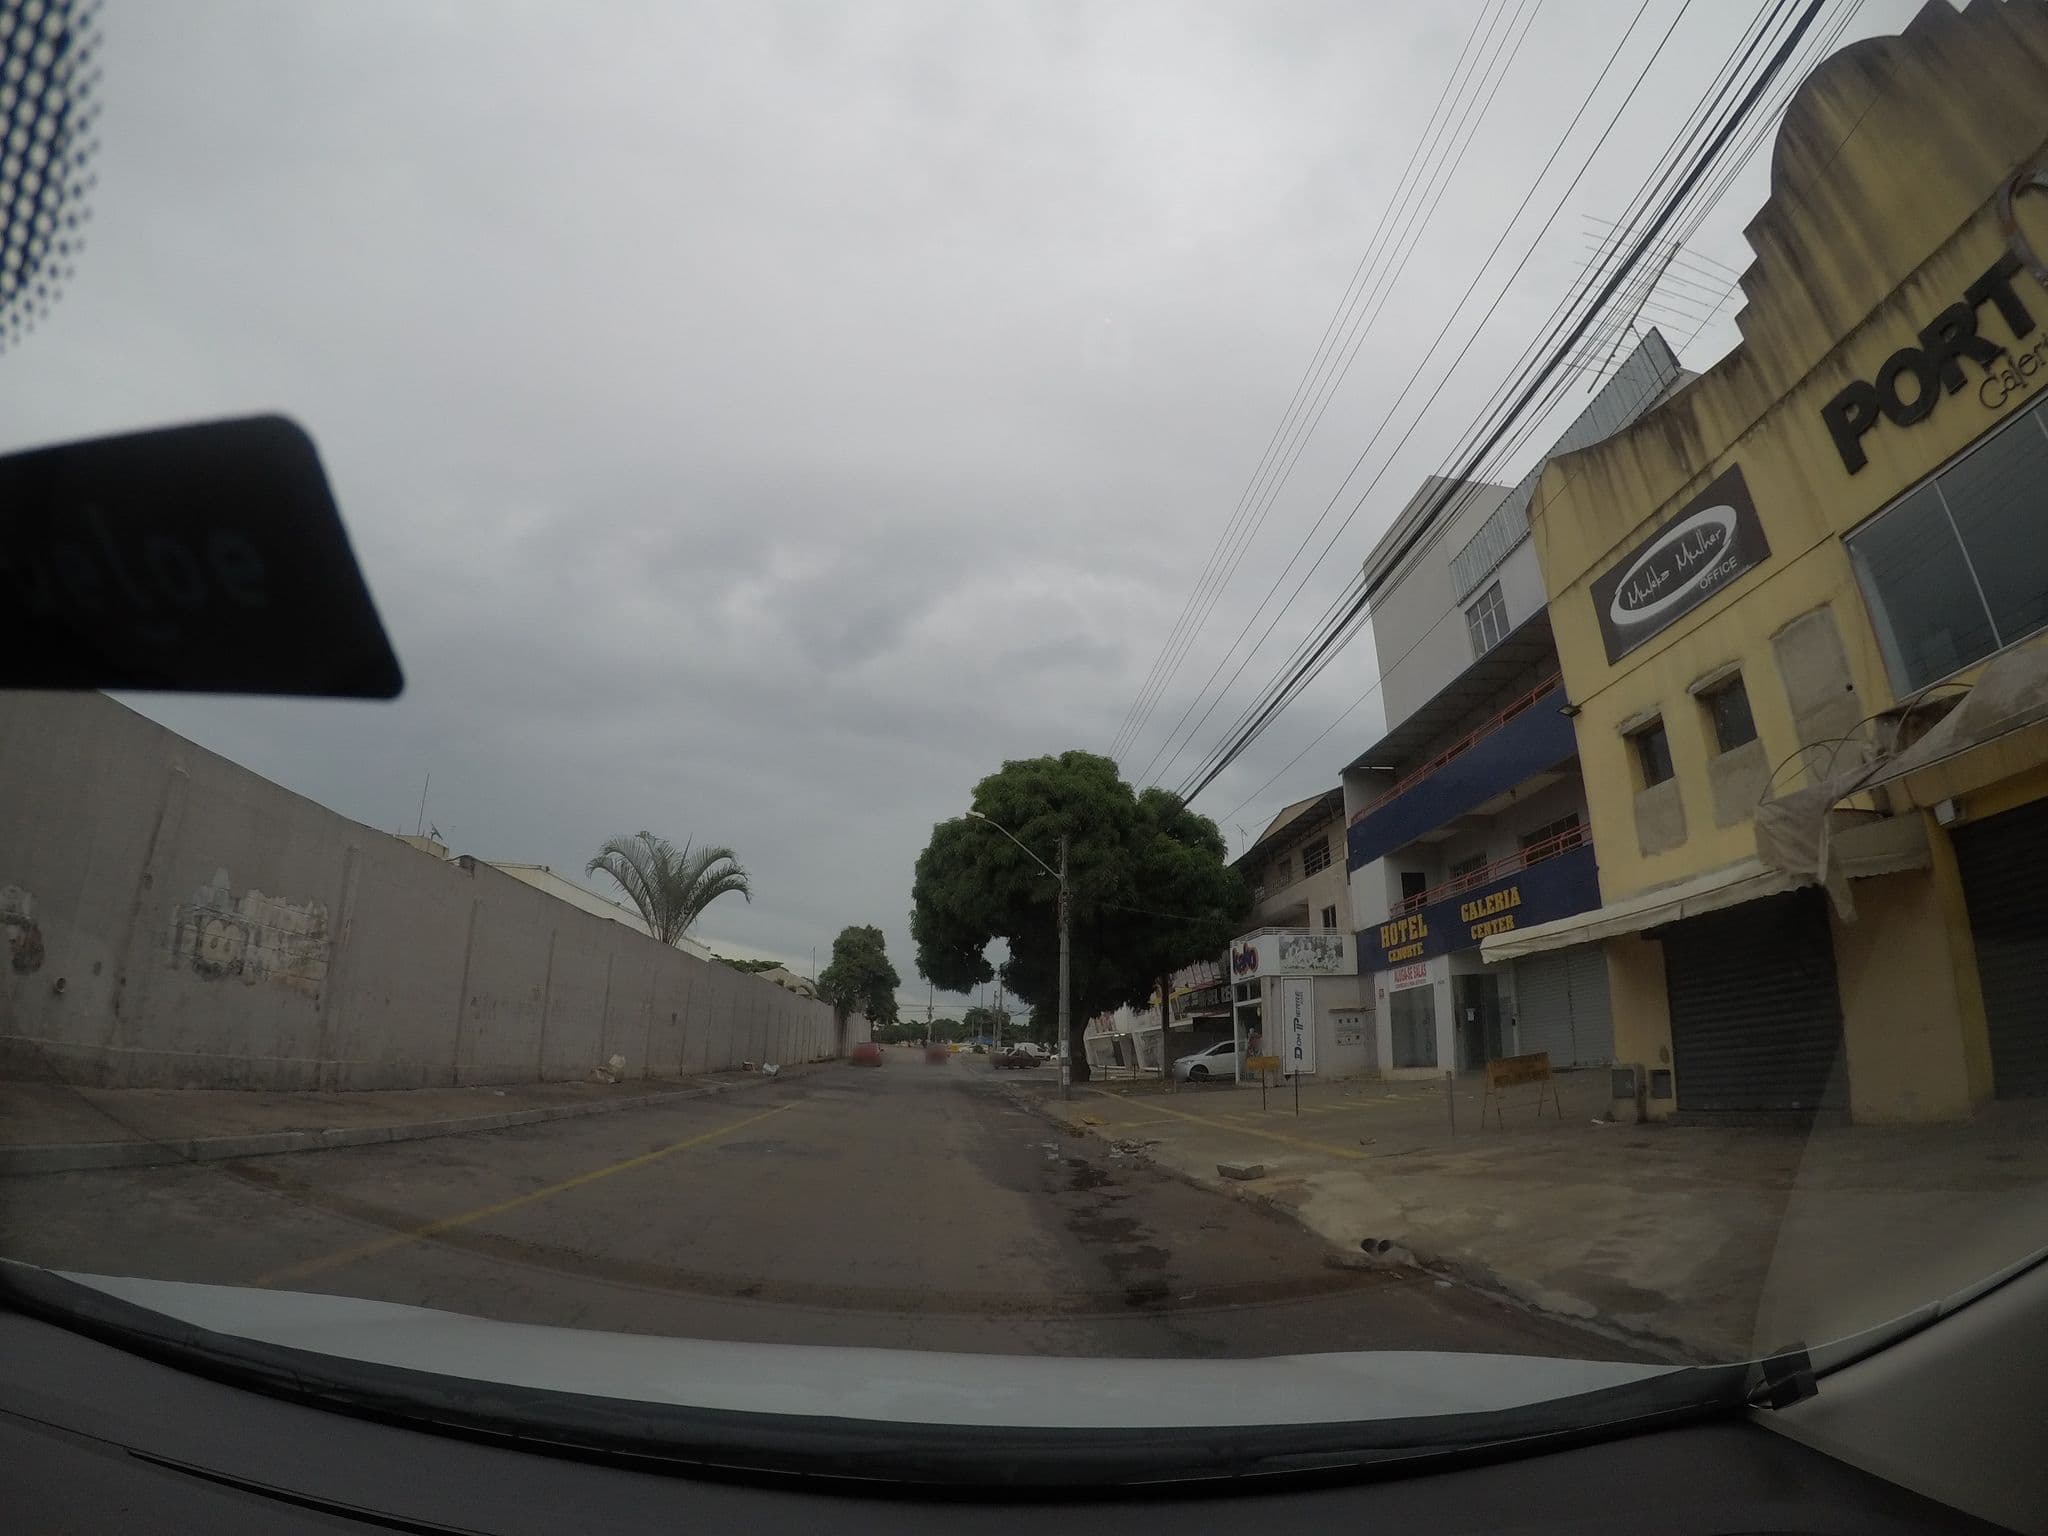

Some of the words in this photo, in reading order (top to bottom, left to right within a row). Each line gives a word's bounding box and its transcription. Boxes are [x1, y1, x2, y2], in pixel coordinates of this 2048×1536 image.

[1820, 250, 2036, 476] PORT
[1675, 528, 1722, 572] Mulher
[1699, 555, 1739, 590] OFFICE
[1460, 886, 1522, 923] GALERIA
[1380, 913, 1429, 949] HOTEL
[1471, 914, 1515, 940] CENTER
